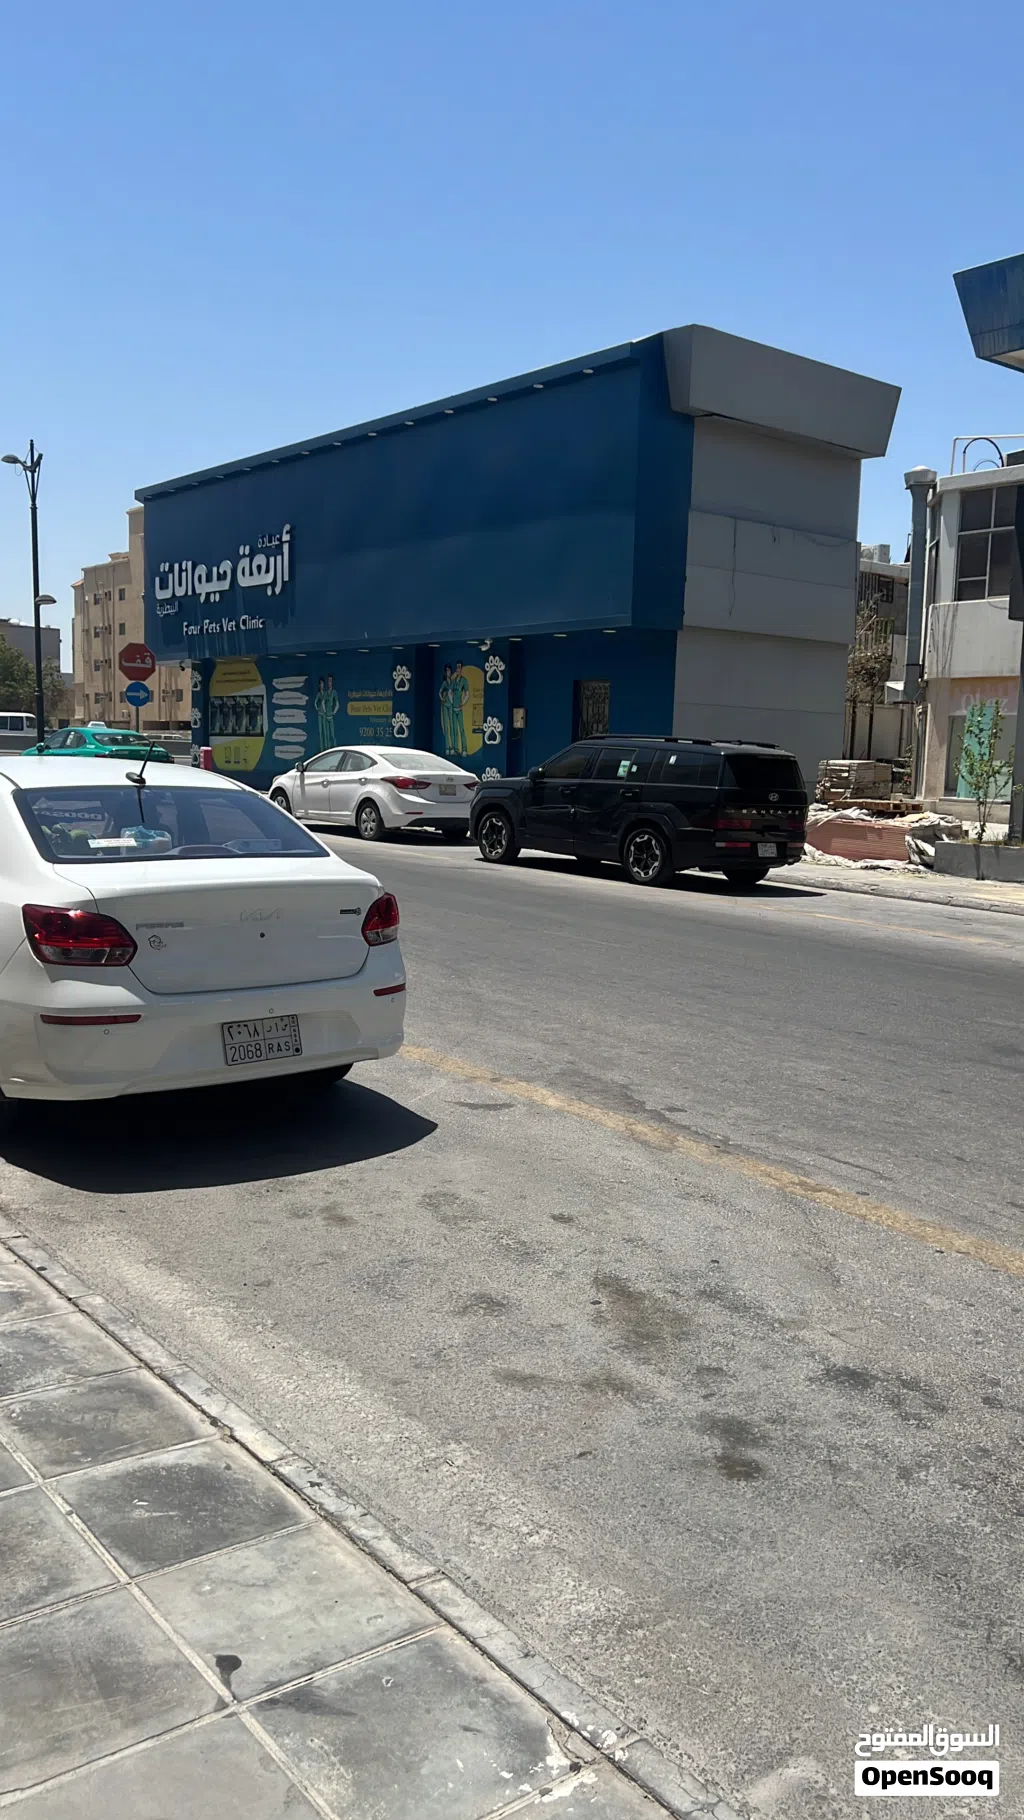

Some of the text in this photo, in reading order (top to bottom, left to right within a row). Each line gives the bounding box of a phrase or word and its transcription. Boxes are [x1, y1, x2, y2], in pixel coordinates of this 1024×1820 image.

[258, 534, 280, 548] عيادة
[155, 524, 291, 604] أربعة حيوانات
[182, 614, 264, 636] Four Pets Vet Clinic
[121, 652, 153, 668] قف
[229, 1040, 291, 1062] 2068 RAS
